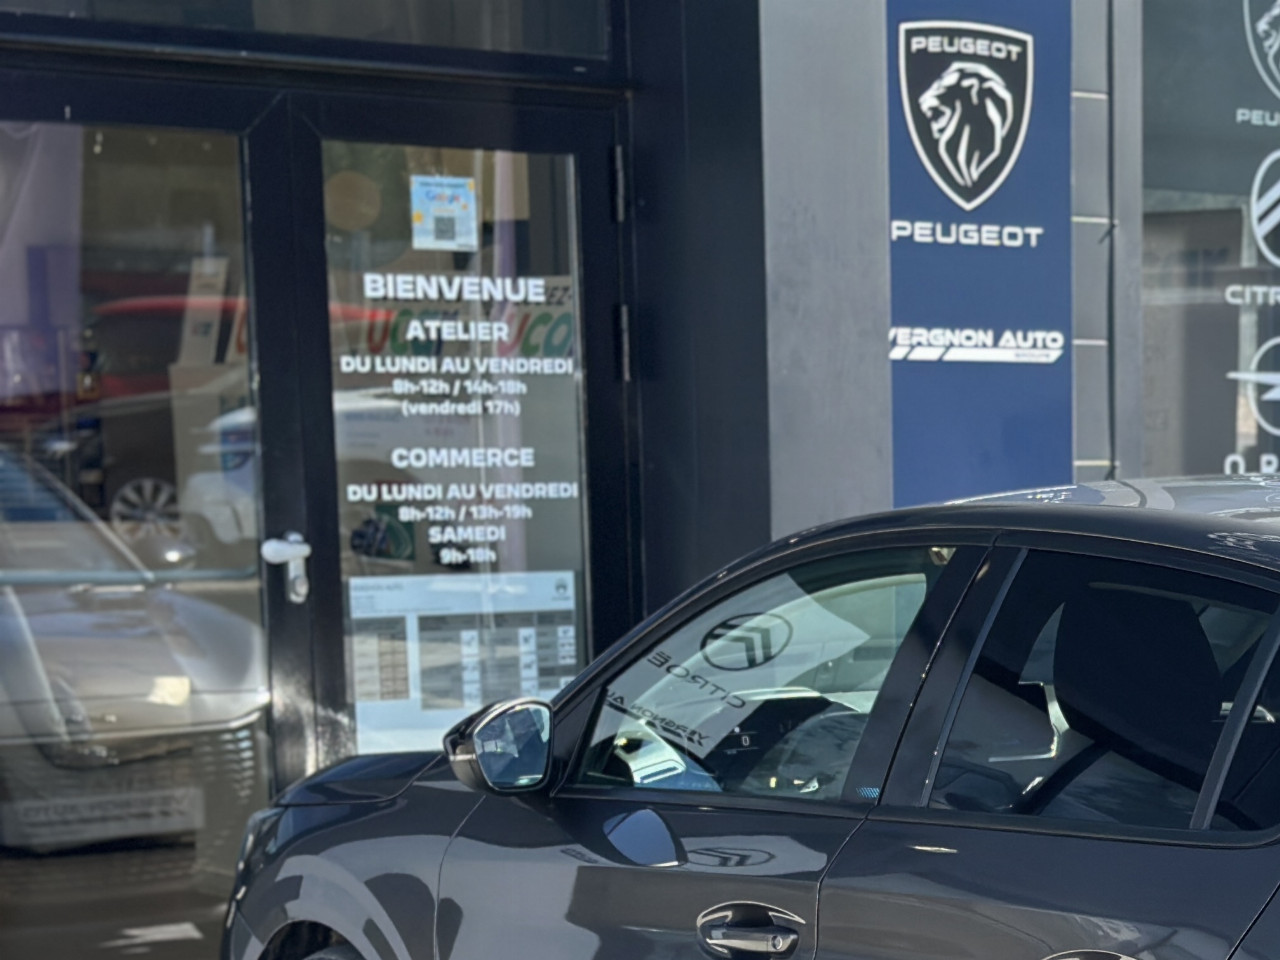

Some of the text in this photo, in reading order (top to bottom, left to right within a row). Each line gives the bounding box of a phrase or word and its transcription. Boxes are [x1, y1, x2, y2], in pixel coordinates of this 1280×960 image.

[911, 36, 1022, 61] PEUGEOT
[891, 220, 1044, 247] PEUGEOT
[363, 273, 546, 302] BIENVENUE
[406, 319, 509, 341] ATELIER
[998, 330, 1065, 349] AUTO
[340, 357, 573, 374] DU LUNDI AU VENDREDI
[392, 378, 450, 395] 8h-12h
[401, 399, 483, 417] (vendredi
[485, 400, 521, 417] 17h)
[391, 448, 535, 468] COMMERCE
[347, 482, 578, 502] DU LUNDI AU VENDREDI
[398, 506, 455, 522] 8h-12h
[428, 526, 507, 544] SAMEDI
